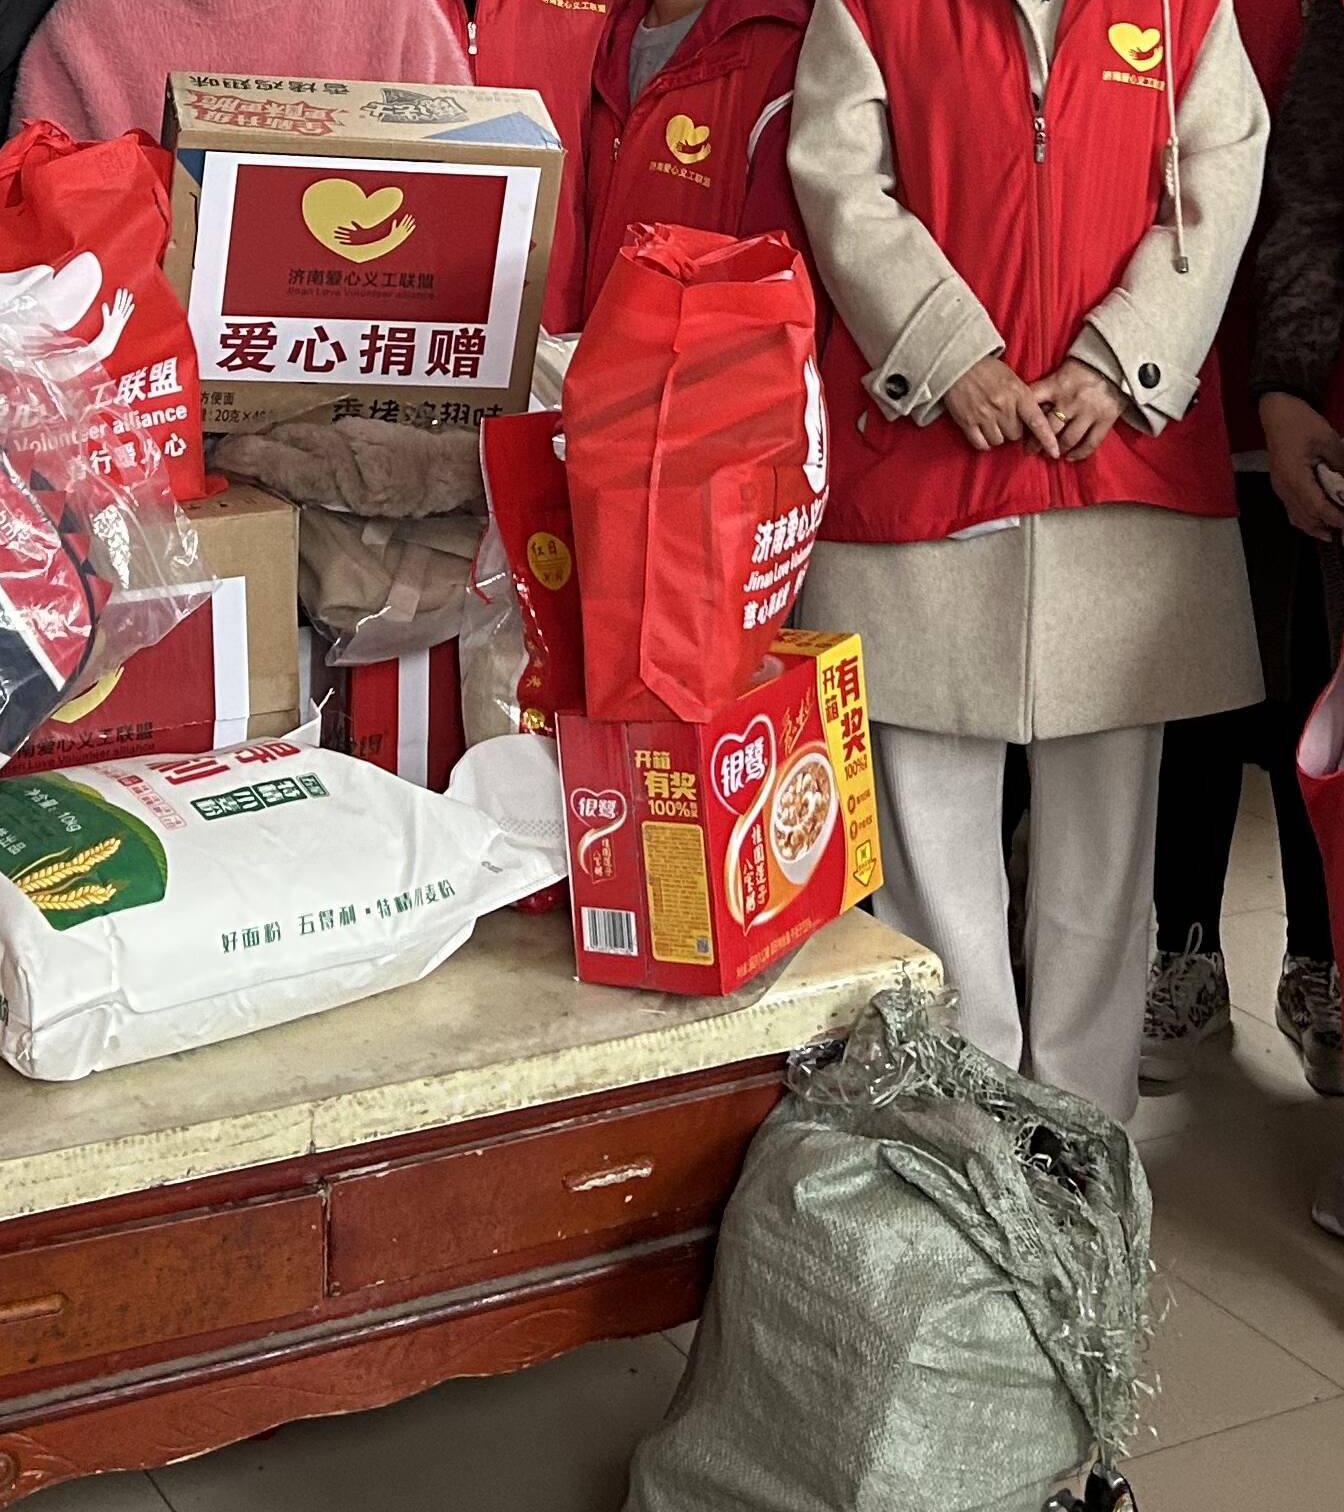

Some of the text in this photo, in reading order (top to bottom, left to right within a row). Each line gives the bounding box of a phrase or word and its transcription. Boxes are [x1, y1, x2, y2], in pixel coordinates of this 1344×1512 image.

[216, 321, 486, 380] 爱心捐赠
[112, 403, 188, 435] alliance
[643, 771, 698, 800] 有奖
[647, 799, 691, 818] 100%
[221, 921, 282, 954] 好面粉
